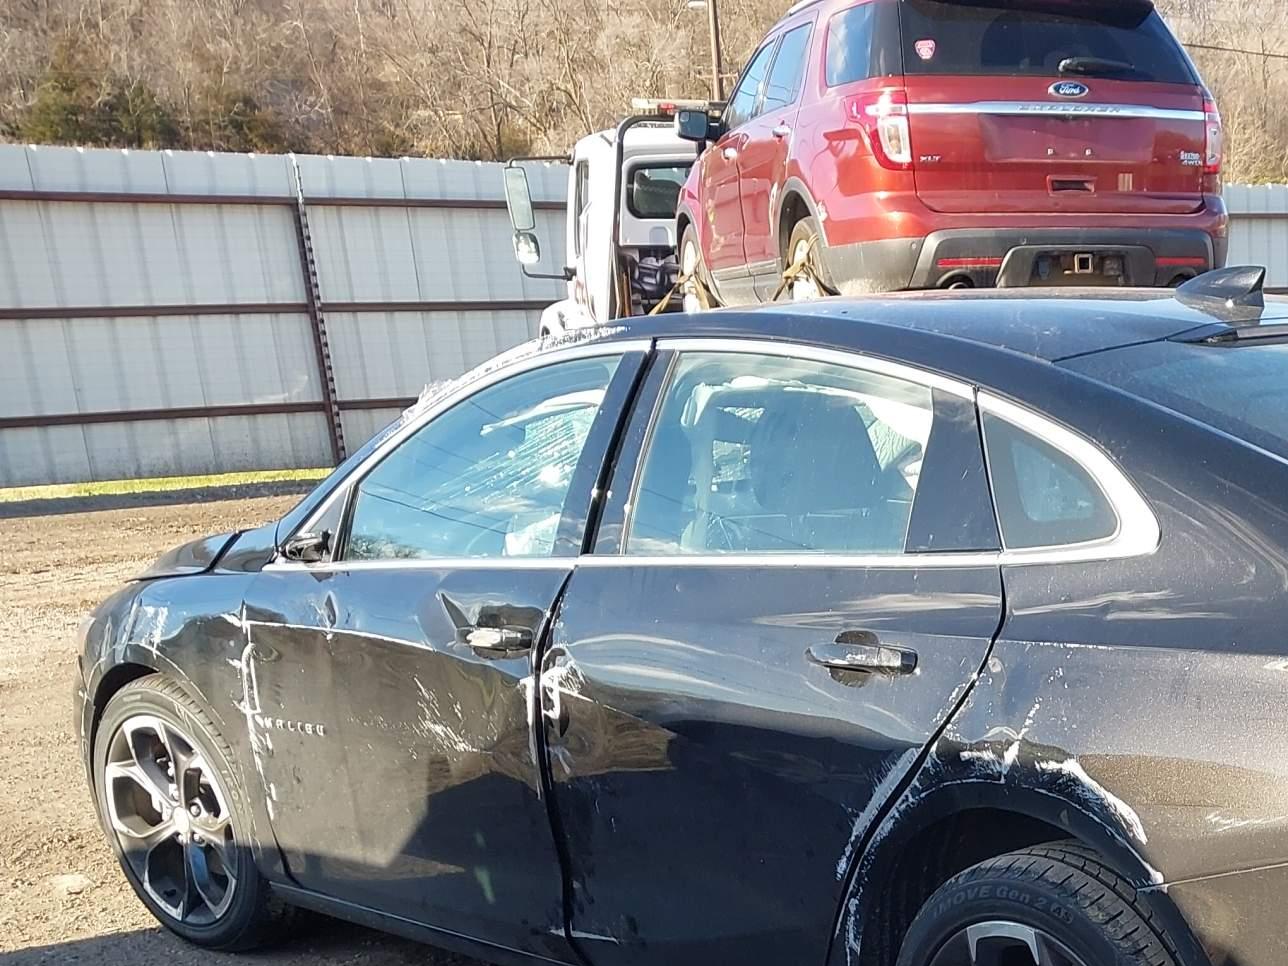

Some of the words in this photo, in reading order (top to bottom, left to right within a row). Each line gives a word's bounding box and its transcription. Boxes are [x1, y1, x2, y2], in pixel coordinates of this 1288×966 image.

[1058, 83, 1081, 95] Ford
[264, 716, 326, 737] MALIBU
[1033, 896, 1048, 908] 2
